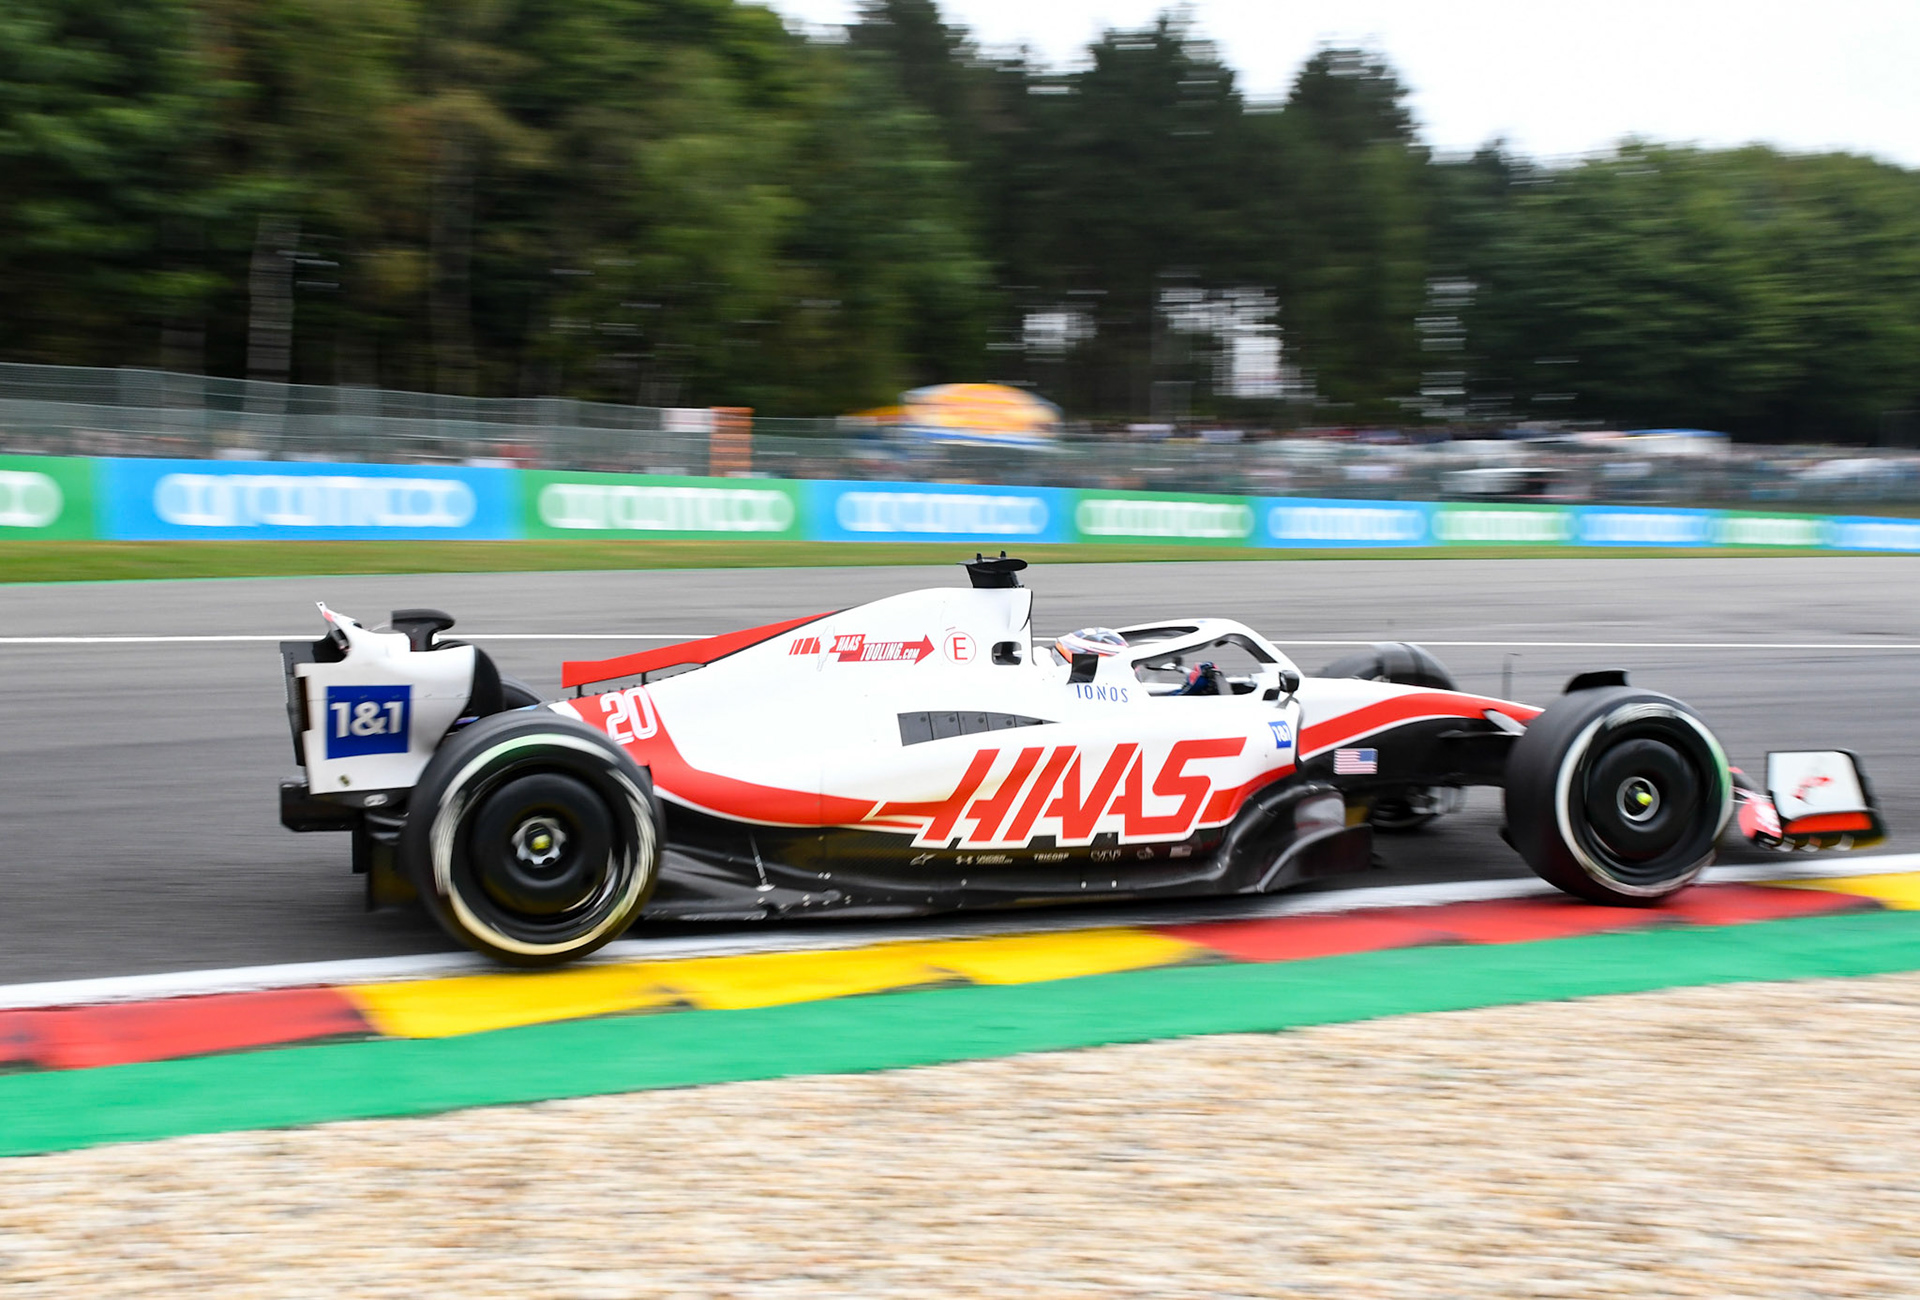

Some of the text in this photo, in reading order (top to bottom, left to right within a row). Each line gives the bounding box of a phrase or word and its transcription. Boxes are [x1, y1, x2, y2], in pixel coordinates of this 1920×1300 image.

[835, 636, 862, 652] HAAS
[952, 637, 969, 660] E
[1076, 683, 1129, 703] IONOS
[329, 701, 404, 738] 1&1
[599, 686, 659, 746] 20
[915, 736, 1248, 844] HAAS
